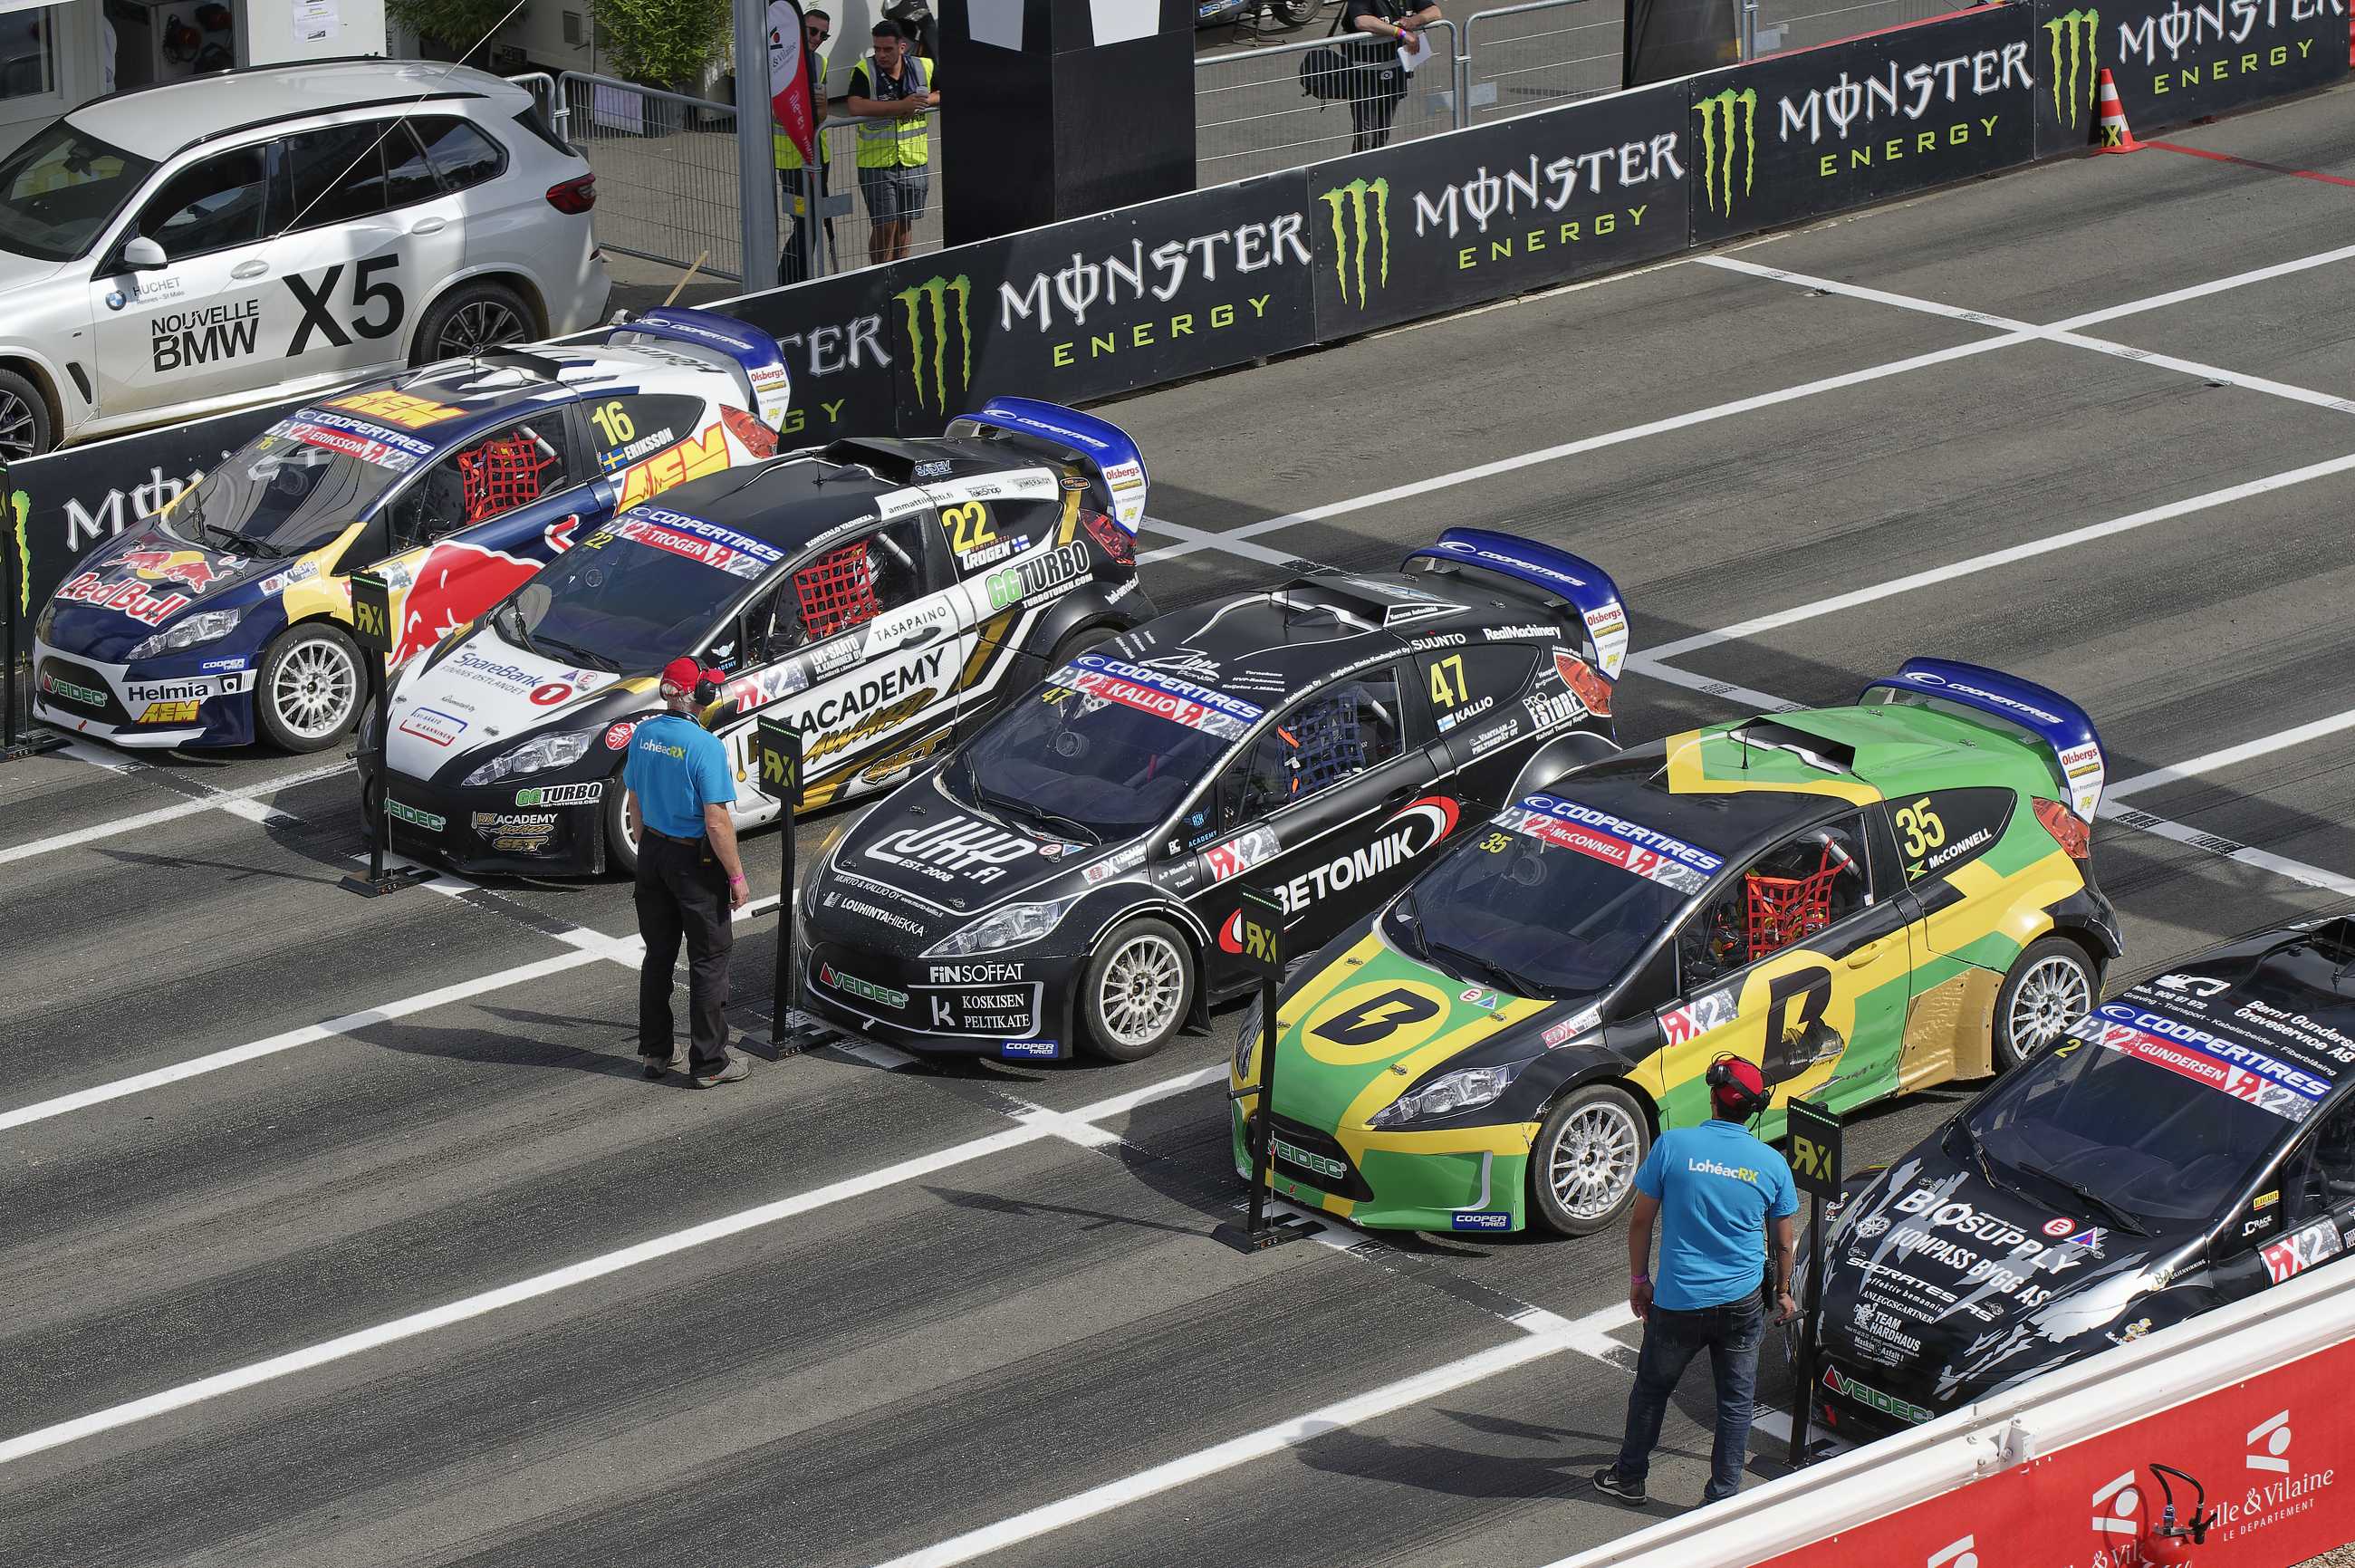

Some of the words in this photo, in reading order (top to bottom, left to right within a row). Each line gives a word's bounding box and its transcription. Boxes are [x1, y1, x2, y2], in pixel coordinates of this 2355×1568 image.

[2154, 39, 2313, 94] ENERGY
[1777, 41, 2033, 144] MONSTER
[1821, 115, 1999, 177] ENERGY
[1413, 131, 1685, 238] MONSTER
[1458, 205, 1648, 270] ENERGY
[133, 276, 180, 297] HUCHET
[997, 212, 1312, 333] MONSTER
[151, 299, 259, 336] NOUVELLE
[282, 253, 404, 358] X5
[153, 318, 259, 372] BMW
[1053, 294, 1271, 368] ENERGY
[751, 369, 783, 381] Olsbergs
[591, 401, 635, 446] 16
[310, 430, 363, 454] ERIKSSON
[624, 428, 674, 460] ERIKSSON
[1106, 466, 1139, 480] Olsbergs
[584, 533, 614, 549] 22
[649, 530, 709, 555] TROGEN
[805, 524, 841, 547] KONETALO
[942, 501, 996, 552] 22
[956, 541, 1011, 570] TROGEN
[1022, 572, 1093, 608] TURBOTUKKU.COM
[357, 601, 384, 636] RX
[875, 607, 946, 641] TASAPAINO
[1483, 625, 1561, 640] RealMachinery
[1588, 609, 1621, 626] Olsbergs
[1412, 633, 1466, 650] SUUNTO
[203, 659, 245, 669] COOPER
[454, 651, 543, 688] SpareBank
[1430, 654, 1468, 707] 47
[50, 679, 107, 707] VEIDEC
[128, 681, 208, 701] Helmia
[795, 647, 945, 736] ACADEMY
[1043, 688, 1074, 706] 47
[1107, 683, 1175, 713] KALLIO
[1523, 692, 1547, 708] PRO
[1456, 697, 1493, 723] KALLIO
[764, 747, 795, 790] RX
[2062, 746, 2097, 765] Olsbergs
[495, 813, 558, 825] ACADEMY
[1896, 797, 1945, 858] 35
[1189, 831, 1216, 847] ACADEMY
[1479, 832, 1513, 853] 35
[1552, 828, 1626, 861] McCONNELL
[1928, 828, 1992, 870] McCONNELL
[834, 874, 857, 887] MURTO
[862, 881, 889, 897] KALLIO
[889, 890, 900, 899] OY
[899, 859, 920, 872] EST.
[922, 864, 955, 882] 2008
[1274, 826, 1416, 916] BETOMIK
[841, 897, 924, 937] LOUHINTAHIEKKA
[1246, 920, 1276, 964] RX
[831, 968, 905, 1009] VEIDEC
[963, 994, 1024, 1009] KOSKISEN
[964, 1014, 1030, 1029] PELTIKATE
[2123, 993, 2157, 1005] Graving
[2164, 1003, 2207, 1020] Transport
[2211, 1019, 2274, 1046] Kabelarbeider
[2235, 1008, 2328, 1050] Graveservice
[1005, 1043, 1054, 1051] COOPER
[2139, 1043, 2226, 1082] GUNDERSEN
[1793, 1134, 1831, 1183] RX
[1888, 1227, 1976, 1269] KOMPASS
[1966, 1260, 2024, 1293] BYGG
[2018, 1287, 2052, 1307] AS
[1846, 1257, 1958, 1303] SOCRATES
[1962, 1303, 1995, 1322] AS
[1866, 1278, 1900, 1294] effektiv
[1861, 1290, 1935, 1324] ANLEGGSGARTNER
[1875, 1311, 1901, 1330] TEAM
[1854, 1336, 1875, 1350] Maskin
[1870, 1323, 1920, 1352] HARDHAUS
[2244, 1487, 2261, 1515] &
[2264, 1469, 2333, 1506] Vilaine
[2224, 1530, 2235, 1541] LE
[2241, 1498, 2314, 1534] DEPARTEMENT
